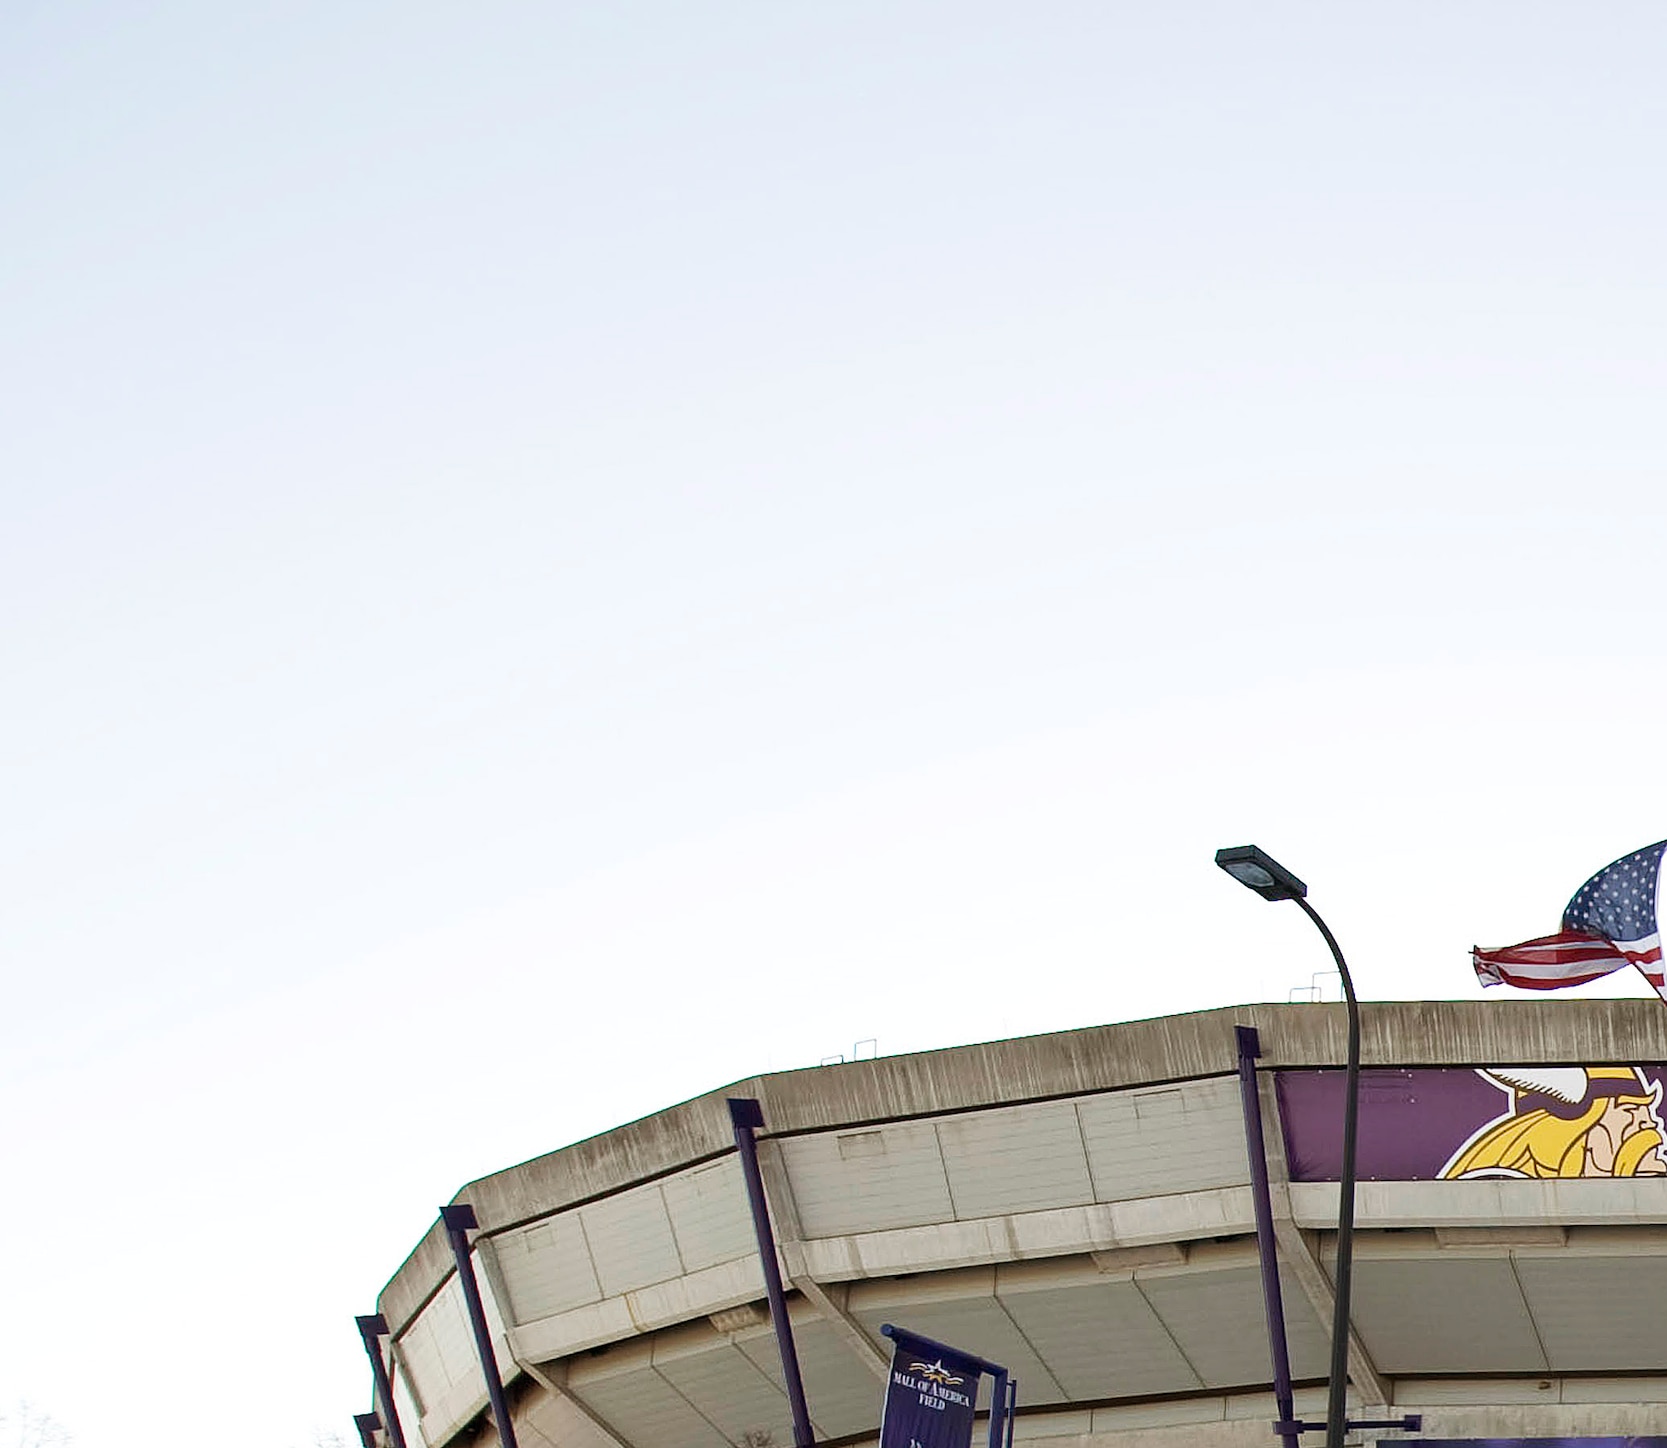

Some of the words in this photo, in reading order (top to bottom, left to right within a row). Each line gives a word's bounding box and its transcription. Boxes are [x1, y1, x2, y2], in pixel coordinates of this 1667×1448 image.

[894, 1371, 917, 1390] MALL
[917, 1380, 930, 1393] OF
[930, 1382, 970, 1407] AMERICA
[919, 1393, 946, 1411] FIELD
